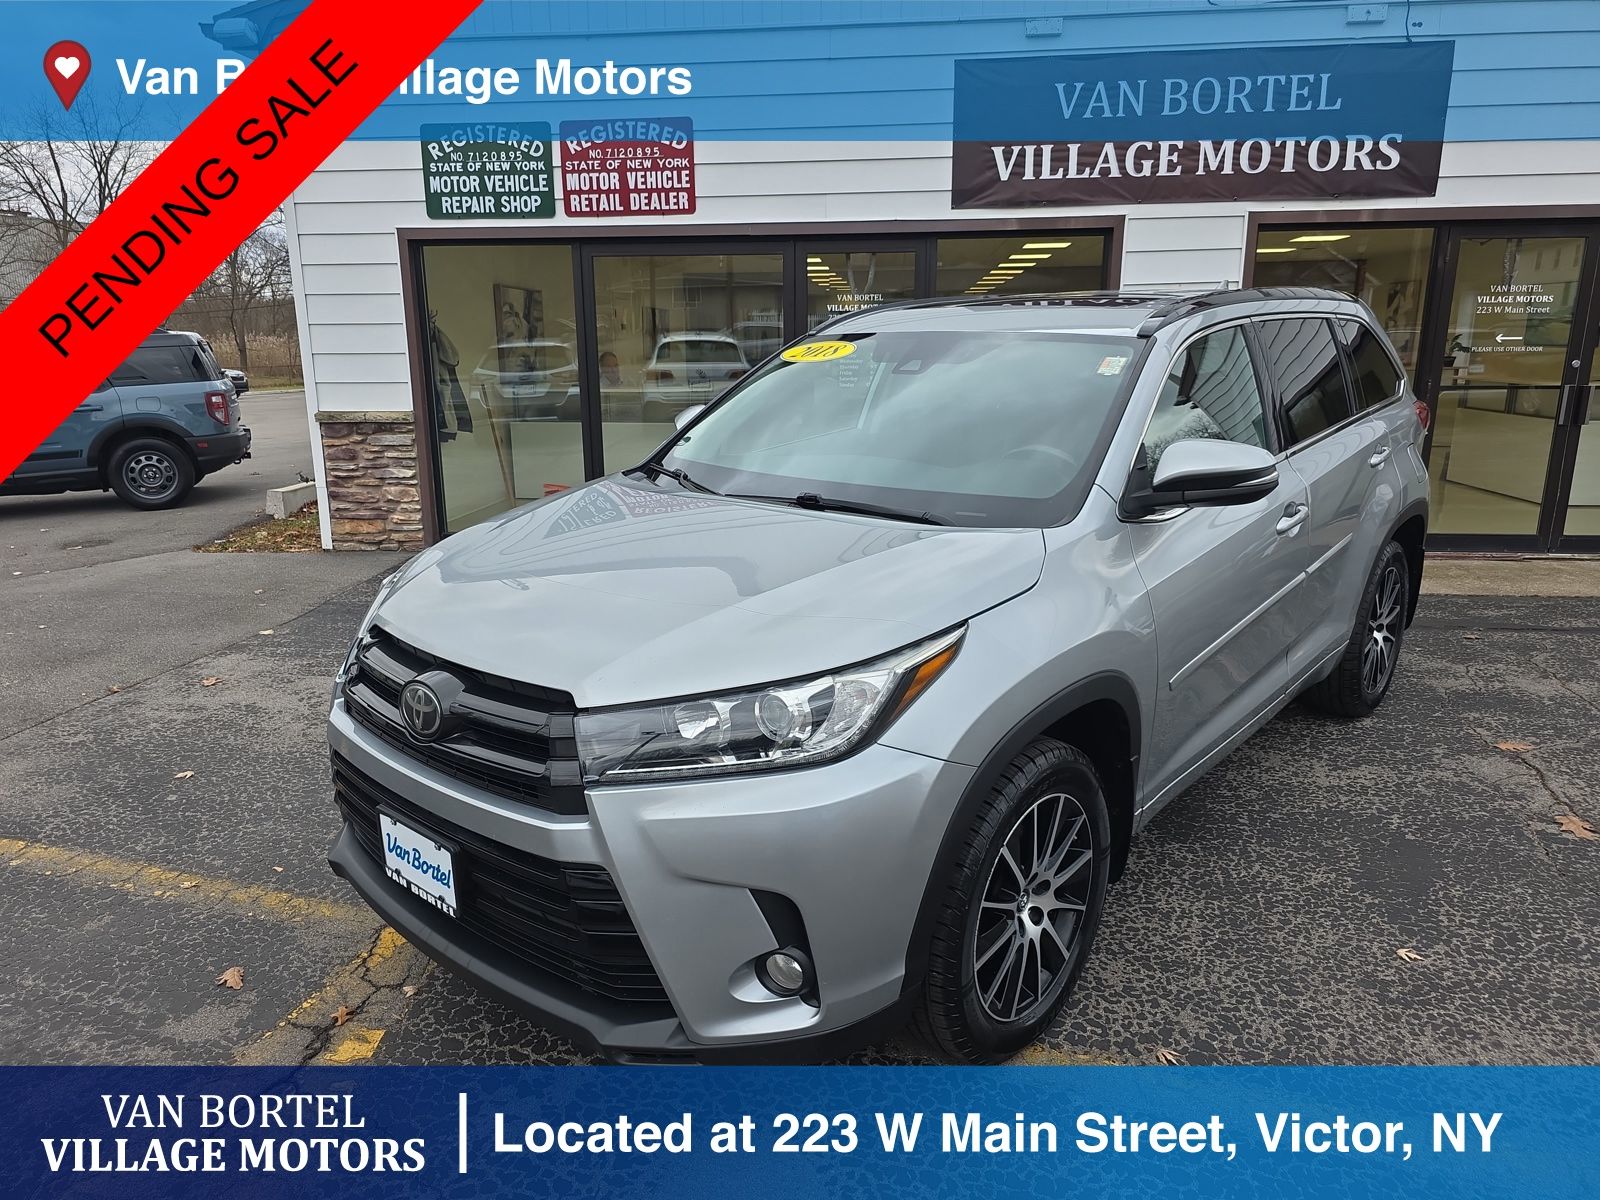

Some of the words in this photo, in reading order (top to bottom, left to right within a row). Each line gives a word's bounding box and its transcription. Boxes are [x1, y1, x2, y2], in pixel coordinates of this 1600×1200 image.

[1055, 79, 1147, 120] VAN
[1161, 72, 1342, 116] BORTEL
[428, 125, 544, 160] REGISTERED
[566, 121, 688, 154] REGISTERED
[606, 147, 660, 157] 7120895
[991, 141, 1184, 182] VILLAGE
[1195, 133, 1403, 176] MOTORS
[430, 162, 463, 172] STATE
[467, 162, 482, 171] OF
[486, 162, 510, 171] NEW
[514, 161, 546, 171] YORK
[566, 161, 601, 170] STATE
[606, 160, 621, 169] OF
[627, 159, 652, 168] NEW
[657, 158, 689, 168] YORK
[429, 175, 480, 193] MOTOR
[484, 174, 548, 192] VEHICLE
[566, 172, 619, 190] MOTOR
[626, 170, 690, 189] VEHICLE
[442, 196, 495, 213] REPAIR
[501, 195, 541, 212] SHOP
[570, 193, 623, 211] RETAIL
[630, 192, 688, 210] DEALER
[1490, 285, 1508, 293] VAN
[1516, 295, 1554, 303] MOTORS
[1526, 305, 1550, 313] Street
[790, 344, 848, 358] 2018
[386, 833, 411, 864] Van
[411, 848, 451, 889] Bortel
[385, 866, 408, 888] VAN
[410, 883, 456, 918] BORTEL
